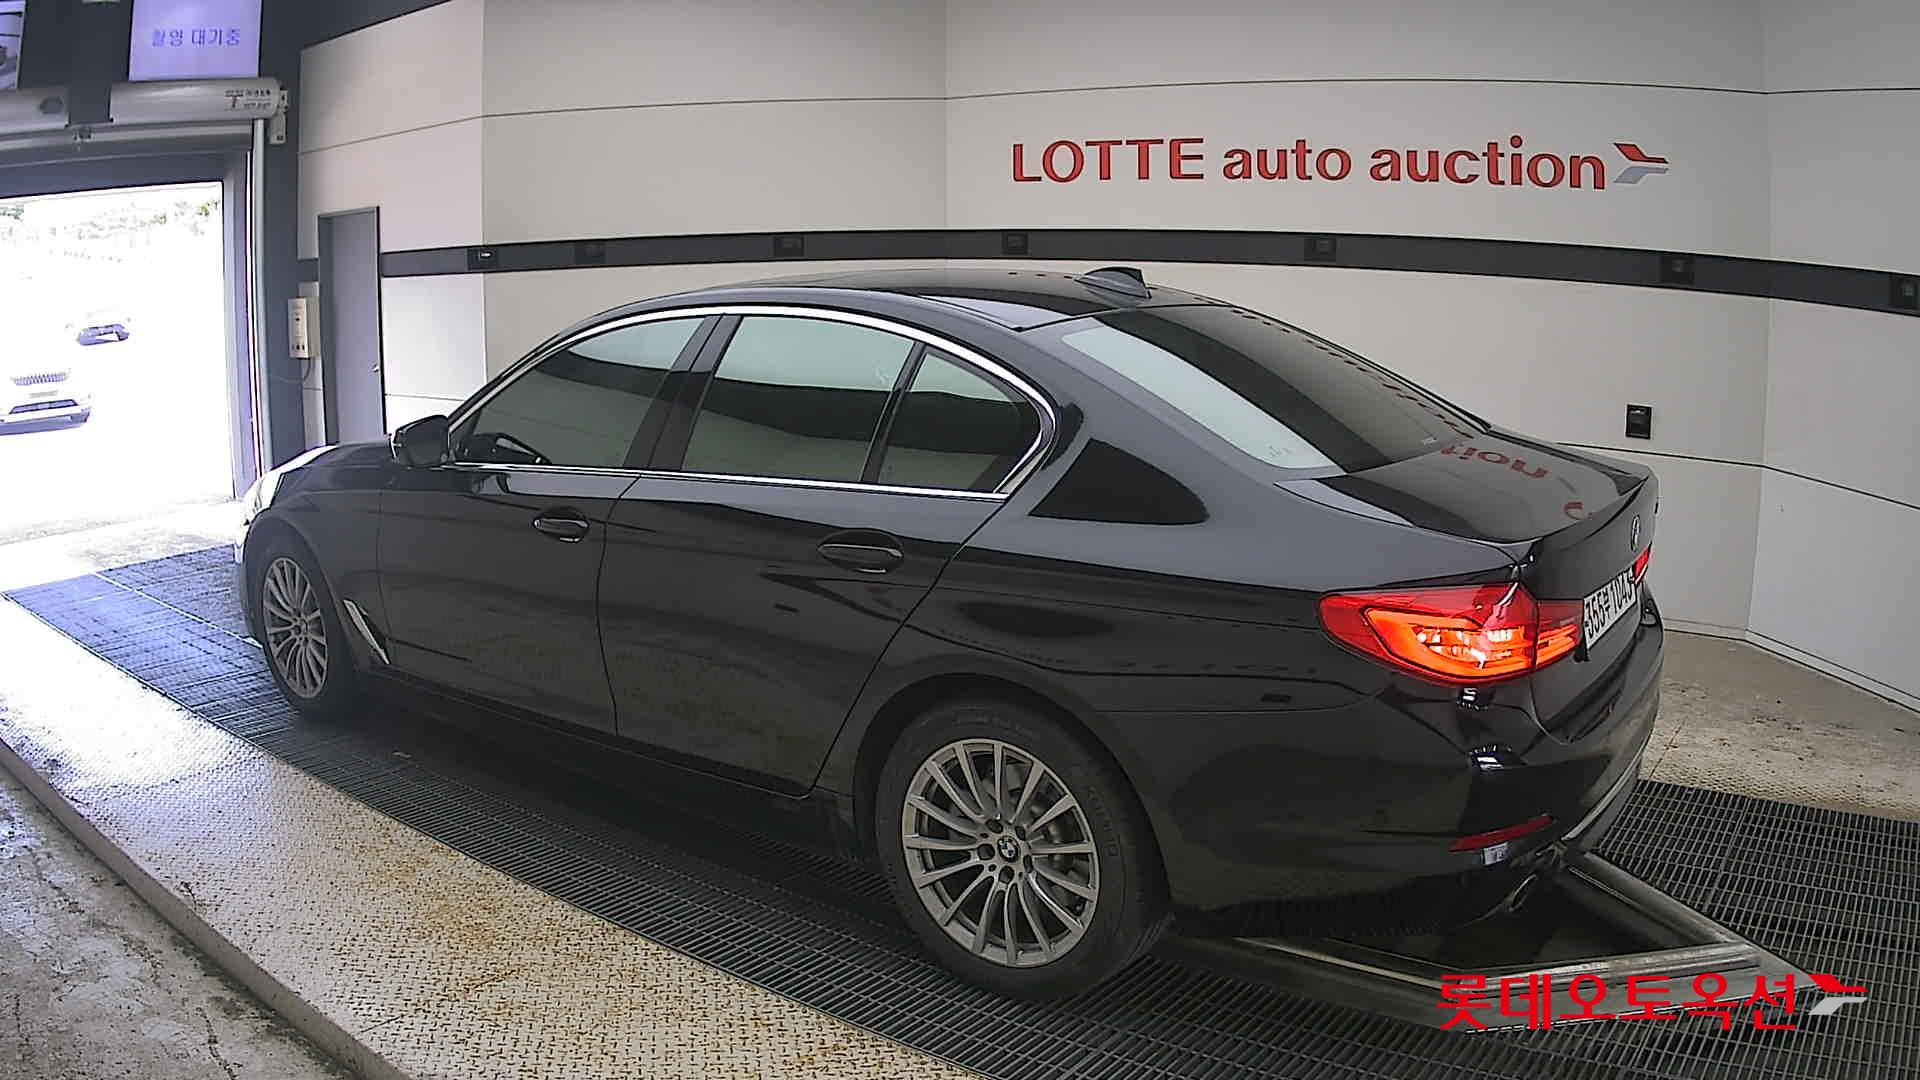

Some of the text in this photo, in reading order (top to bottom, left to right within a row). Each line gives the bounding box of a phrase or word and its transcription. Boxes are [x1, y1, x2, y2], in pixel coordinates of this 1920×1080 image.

[191, 28, 240, 47] 대기중
[1013, 136, 1607, 190] LOTTE auto auction
